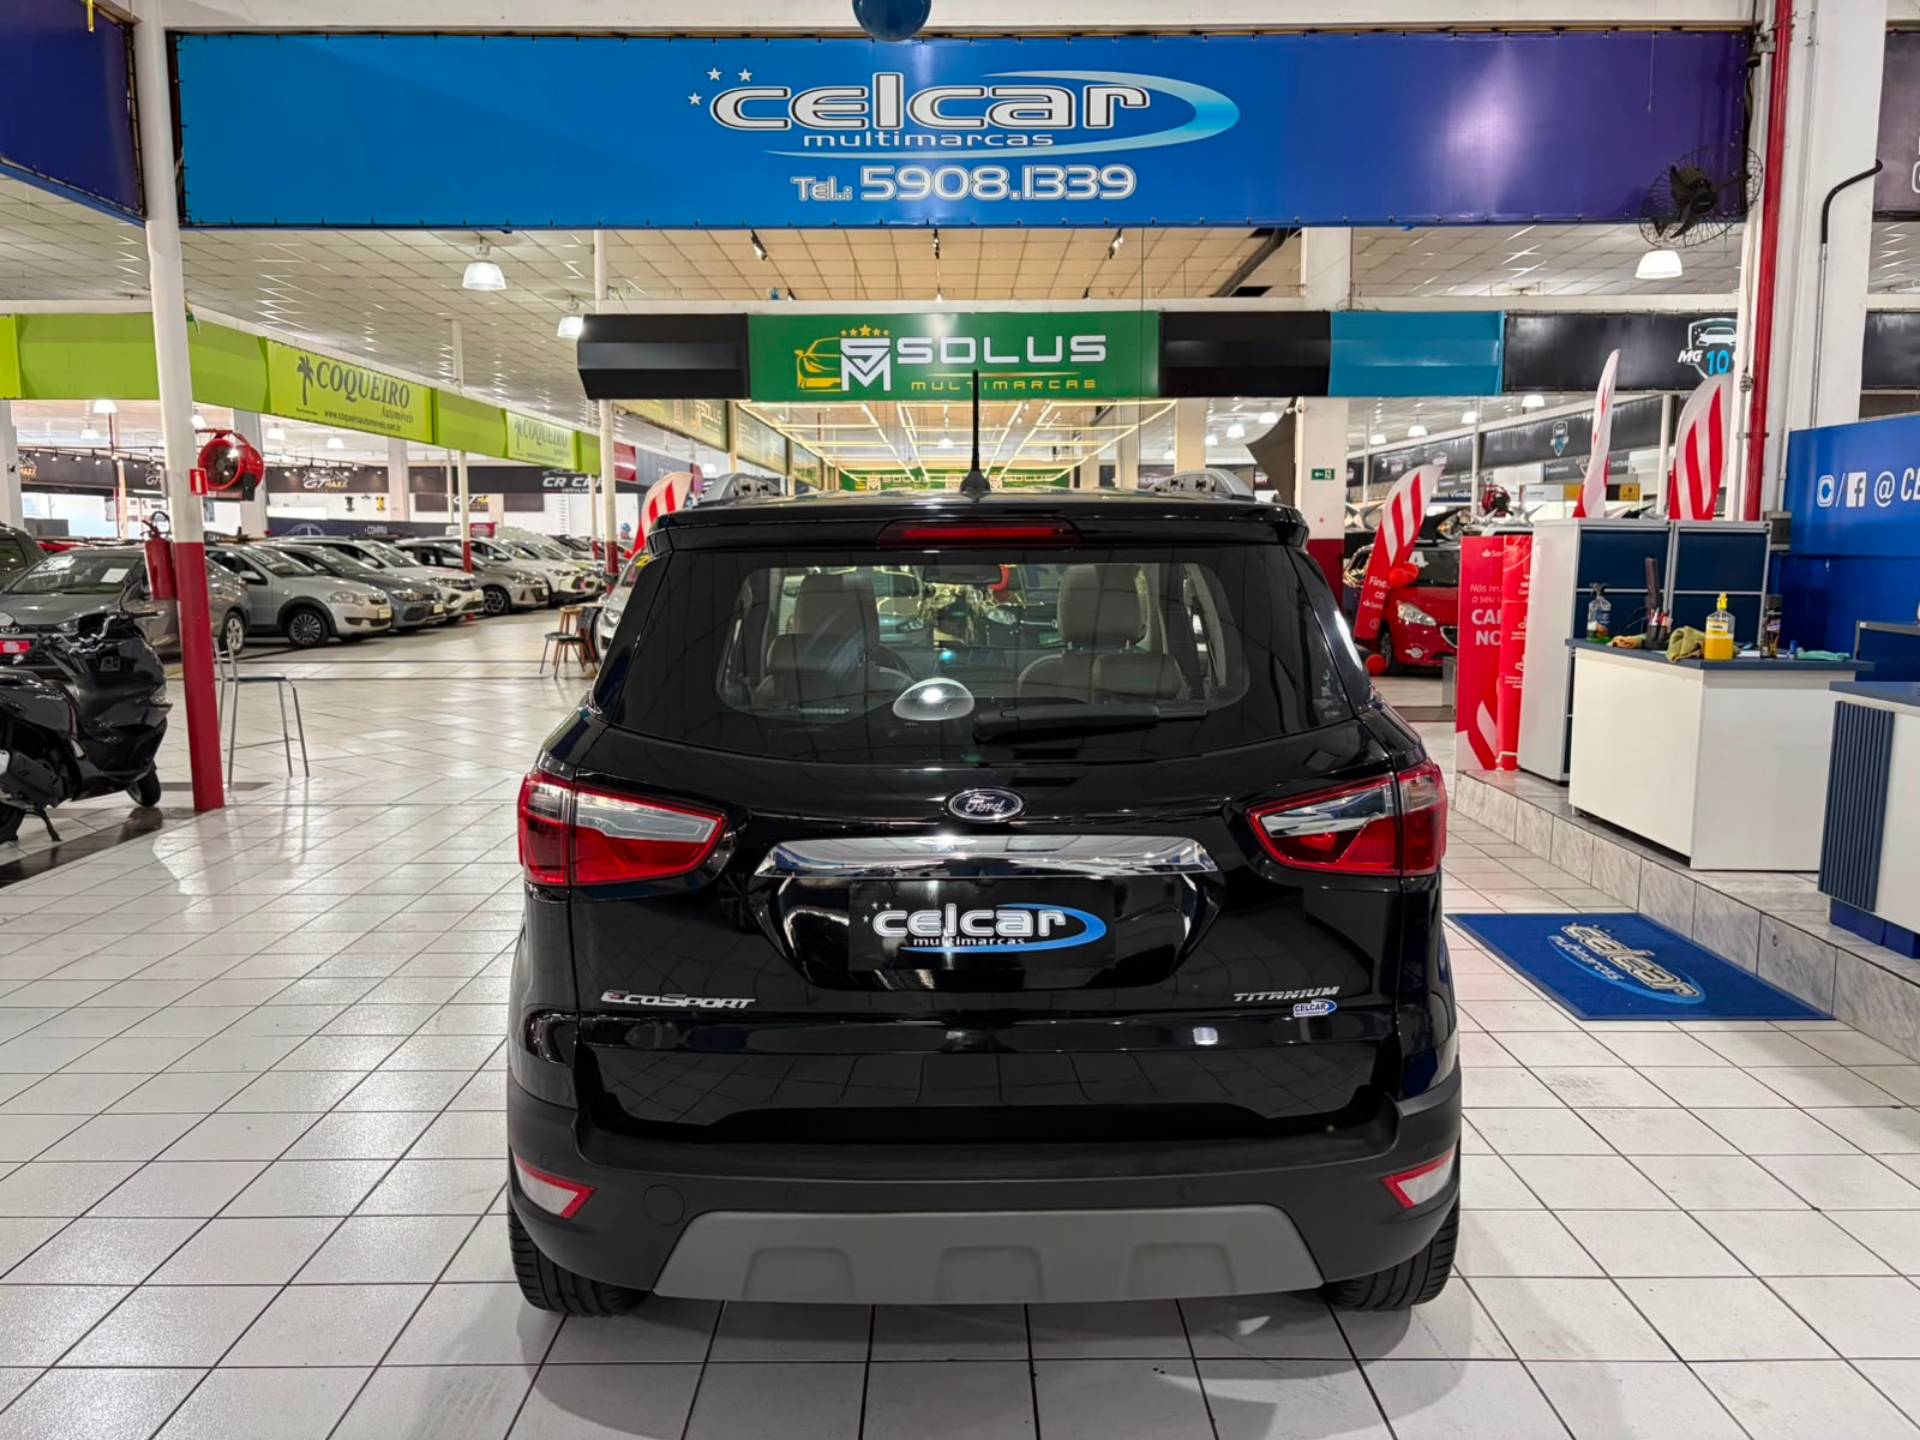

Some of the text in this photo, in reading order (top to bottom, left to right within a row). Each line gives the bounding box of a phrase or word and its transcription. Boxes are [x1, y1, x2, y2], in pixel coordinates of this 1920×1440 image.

[709, 72, 1151, 131] celcar
[803, 131, 1054, 148] multimarcas
[860, 165, 1138, 202] 5908.1339
[897, 335, 1107, 365] SOLUS
[1677, 349, 1703, 363] MG
[316, 360, 410, 409] COQUEIRO
[911, 379, 1097, 391] MULTIMARCAS
[543, 477, 567, 487] CR
[965, 793, 1005, 813] Ford
[872, 903, 1067, 937] celcar
[913, 936, 1026, 946] multimarcas
[1233, 986, 1340, 1002] TITANIUM
[1294, 1003, 1328, 1013] CELCAR
